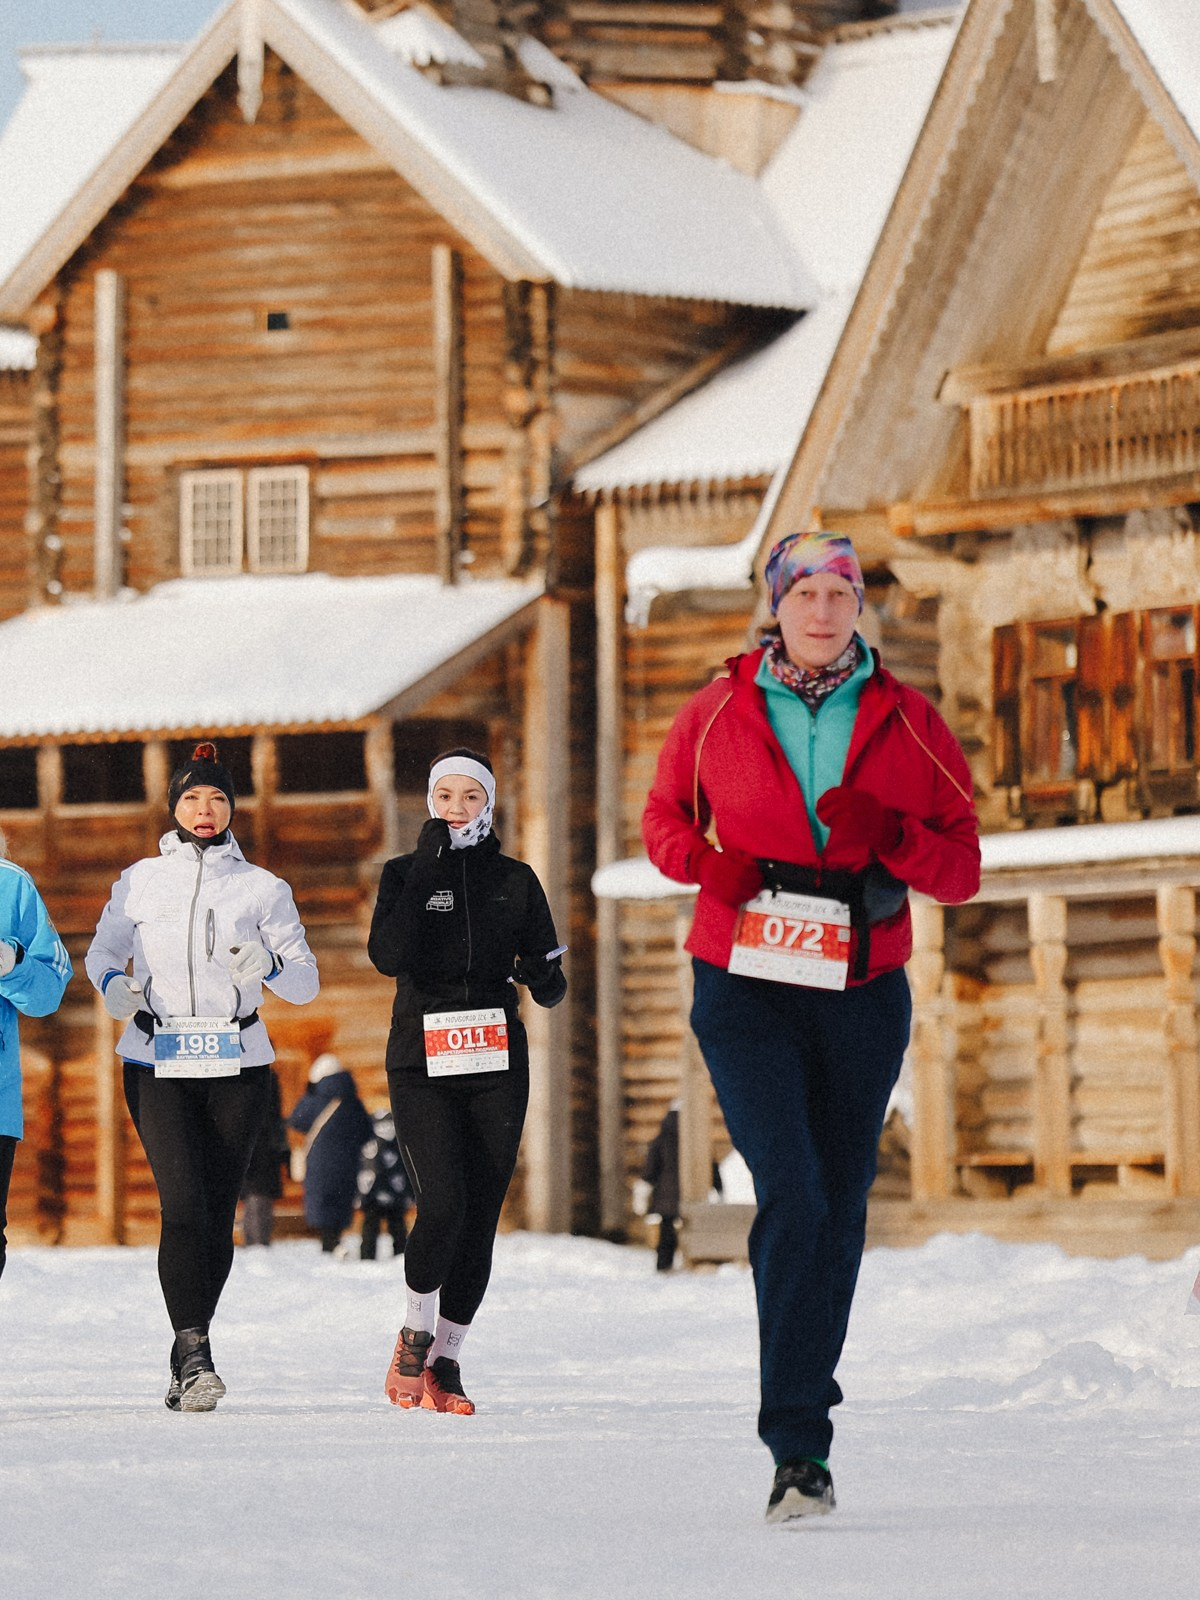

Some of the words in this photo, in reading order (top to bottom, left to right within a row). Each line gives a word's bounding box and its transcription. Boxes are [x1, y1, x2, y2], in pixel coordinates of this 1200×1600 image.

[763, 916, 824, 952] 072
[176, 1034, 220, 1055] 198
[447, 1027, 488, 1050] 011
